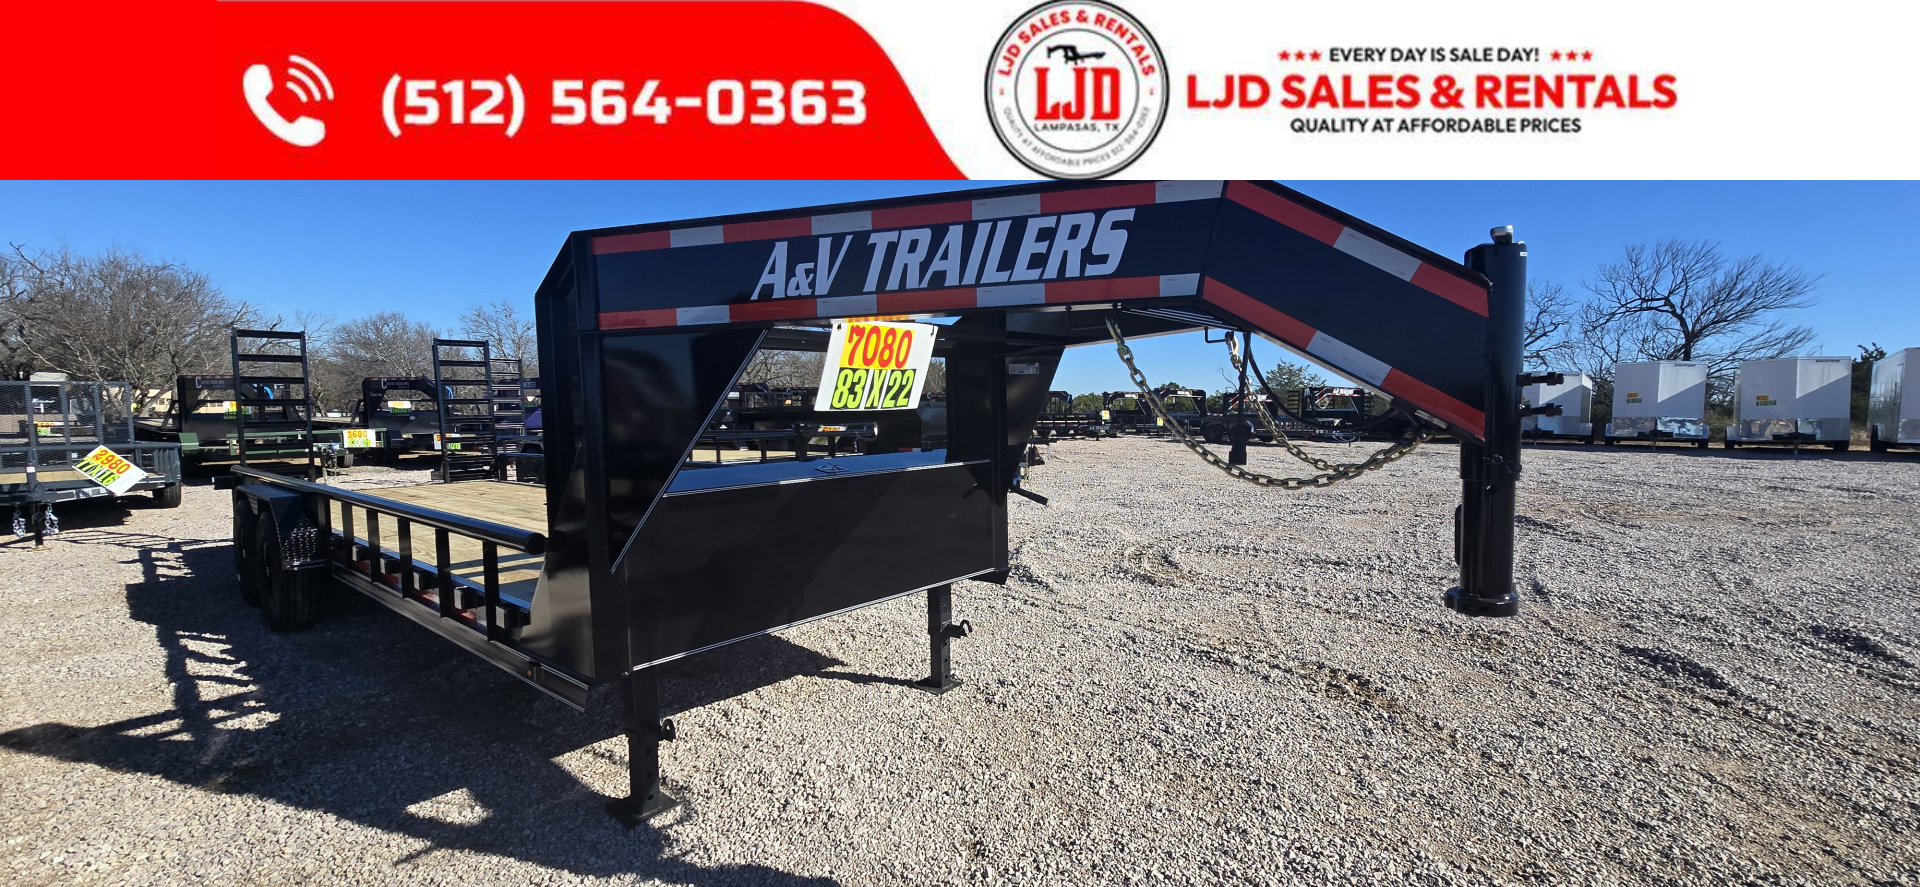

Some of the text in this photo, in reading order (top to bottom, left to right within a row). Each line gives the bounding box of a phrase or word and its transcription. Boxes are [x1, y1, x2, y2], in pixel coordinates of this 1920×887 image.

[750, 208, 1135, 300] A&V TRAILERS
[848, 325, 913, 369] 7080
[92, 449, 131, 475] 2980
